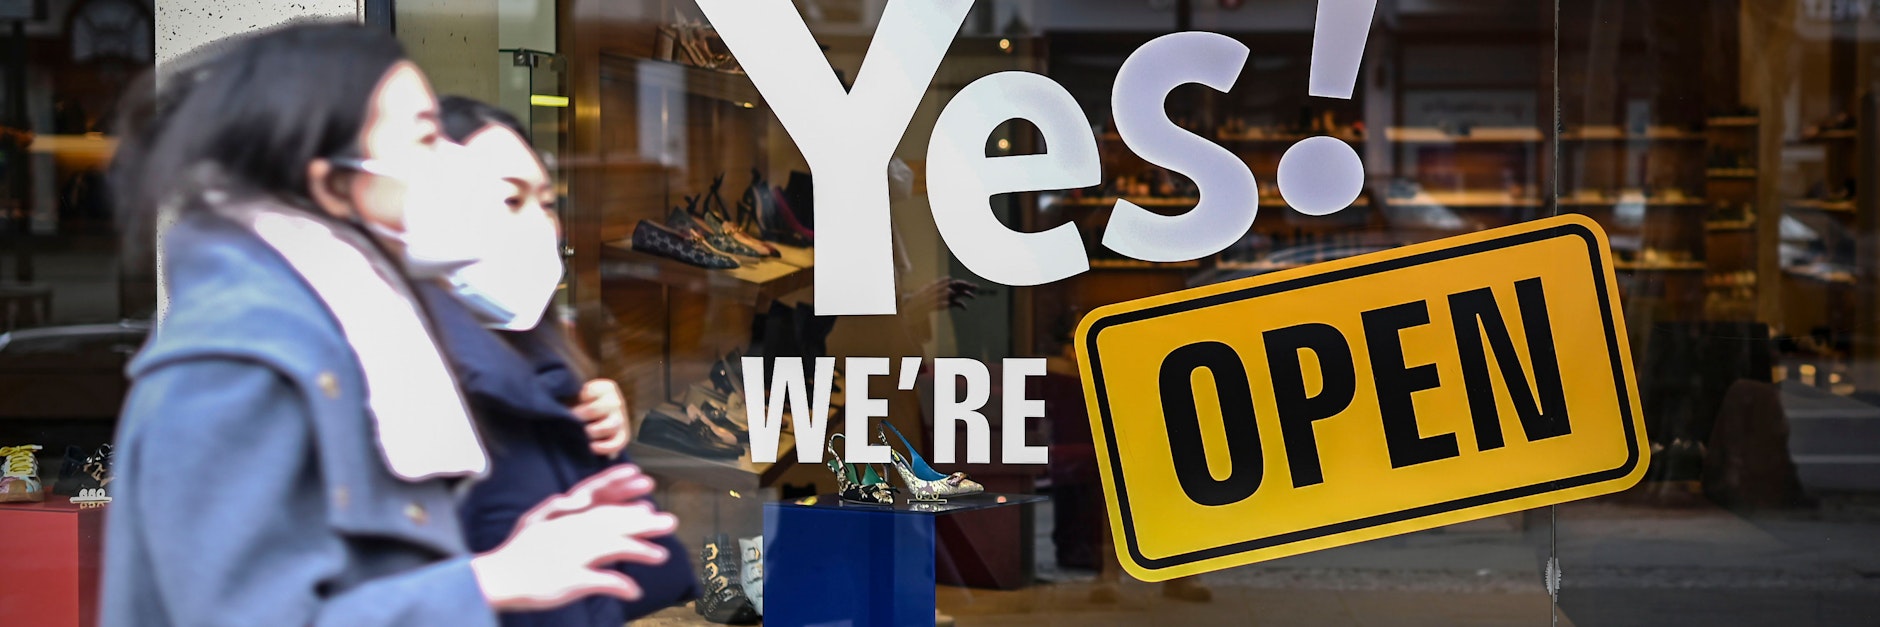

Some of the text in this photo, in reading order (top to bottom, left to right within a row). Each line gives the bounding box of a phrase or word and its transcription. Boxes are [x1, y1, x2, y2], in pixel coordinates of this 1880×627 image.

[694, 0, 1377, 316] Yes!
[741, 356, 1049, 464] WE'RE
[1159, 277, 1572, 507] OPEN
